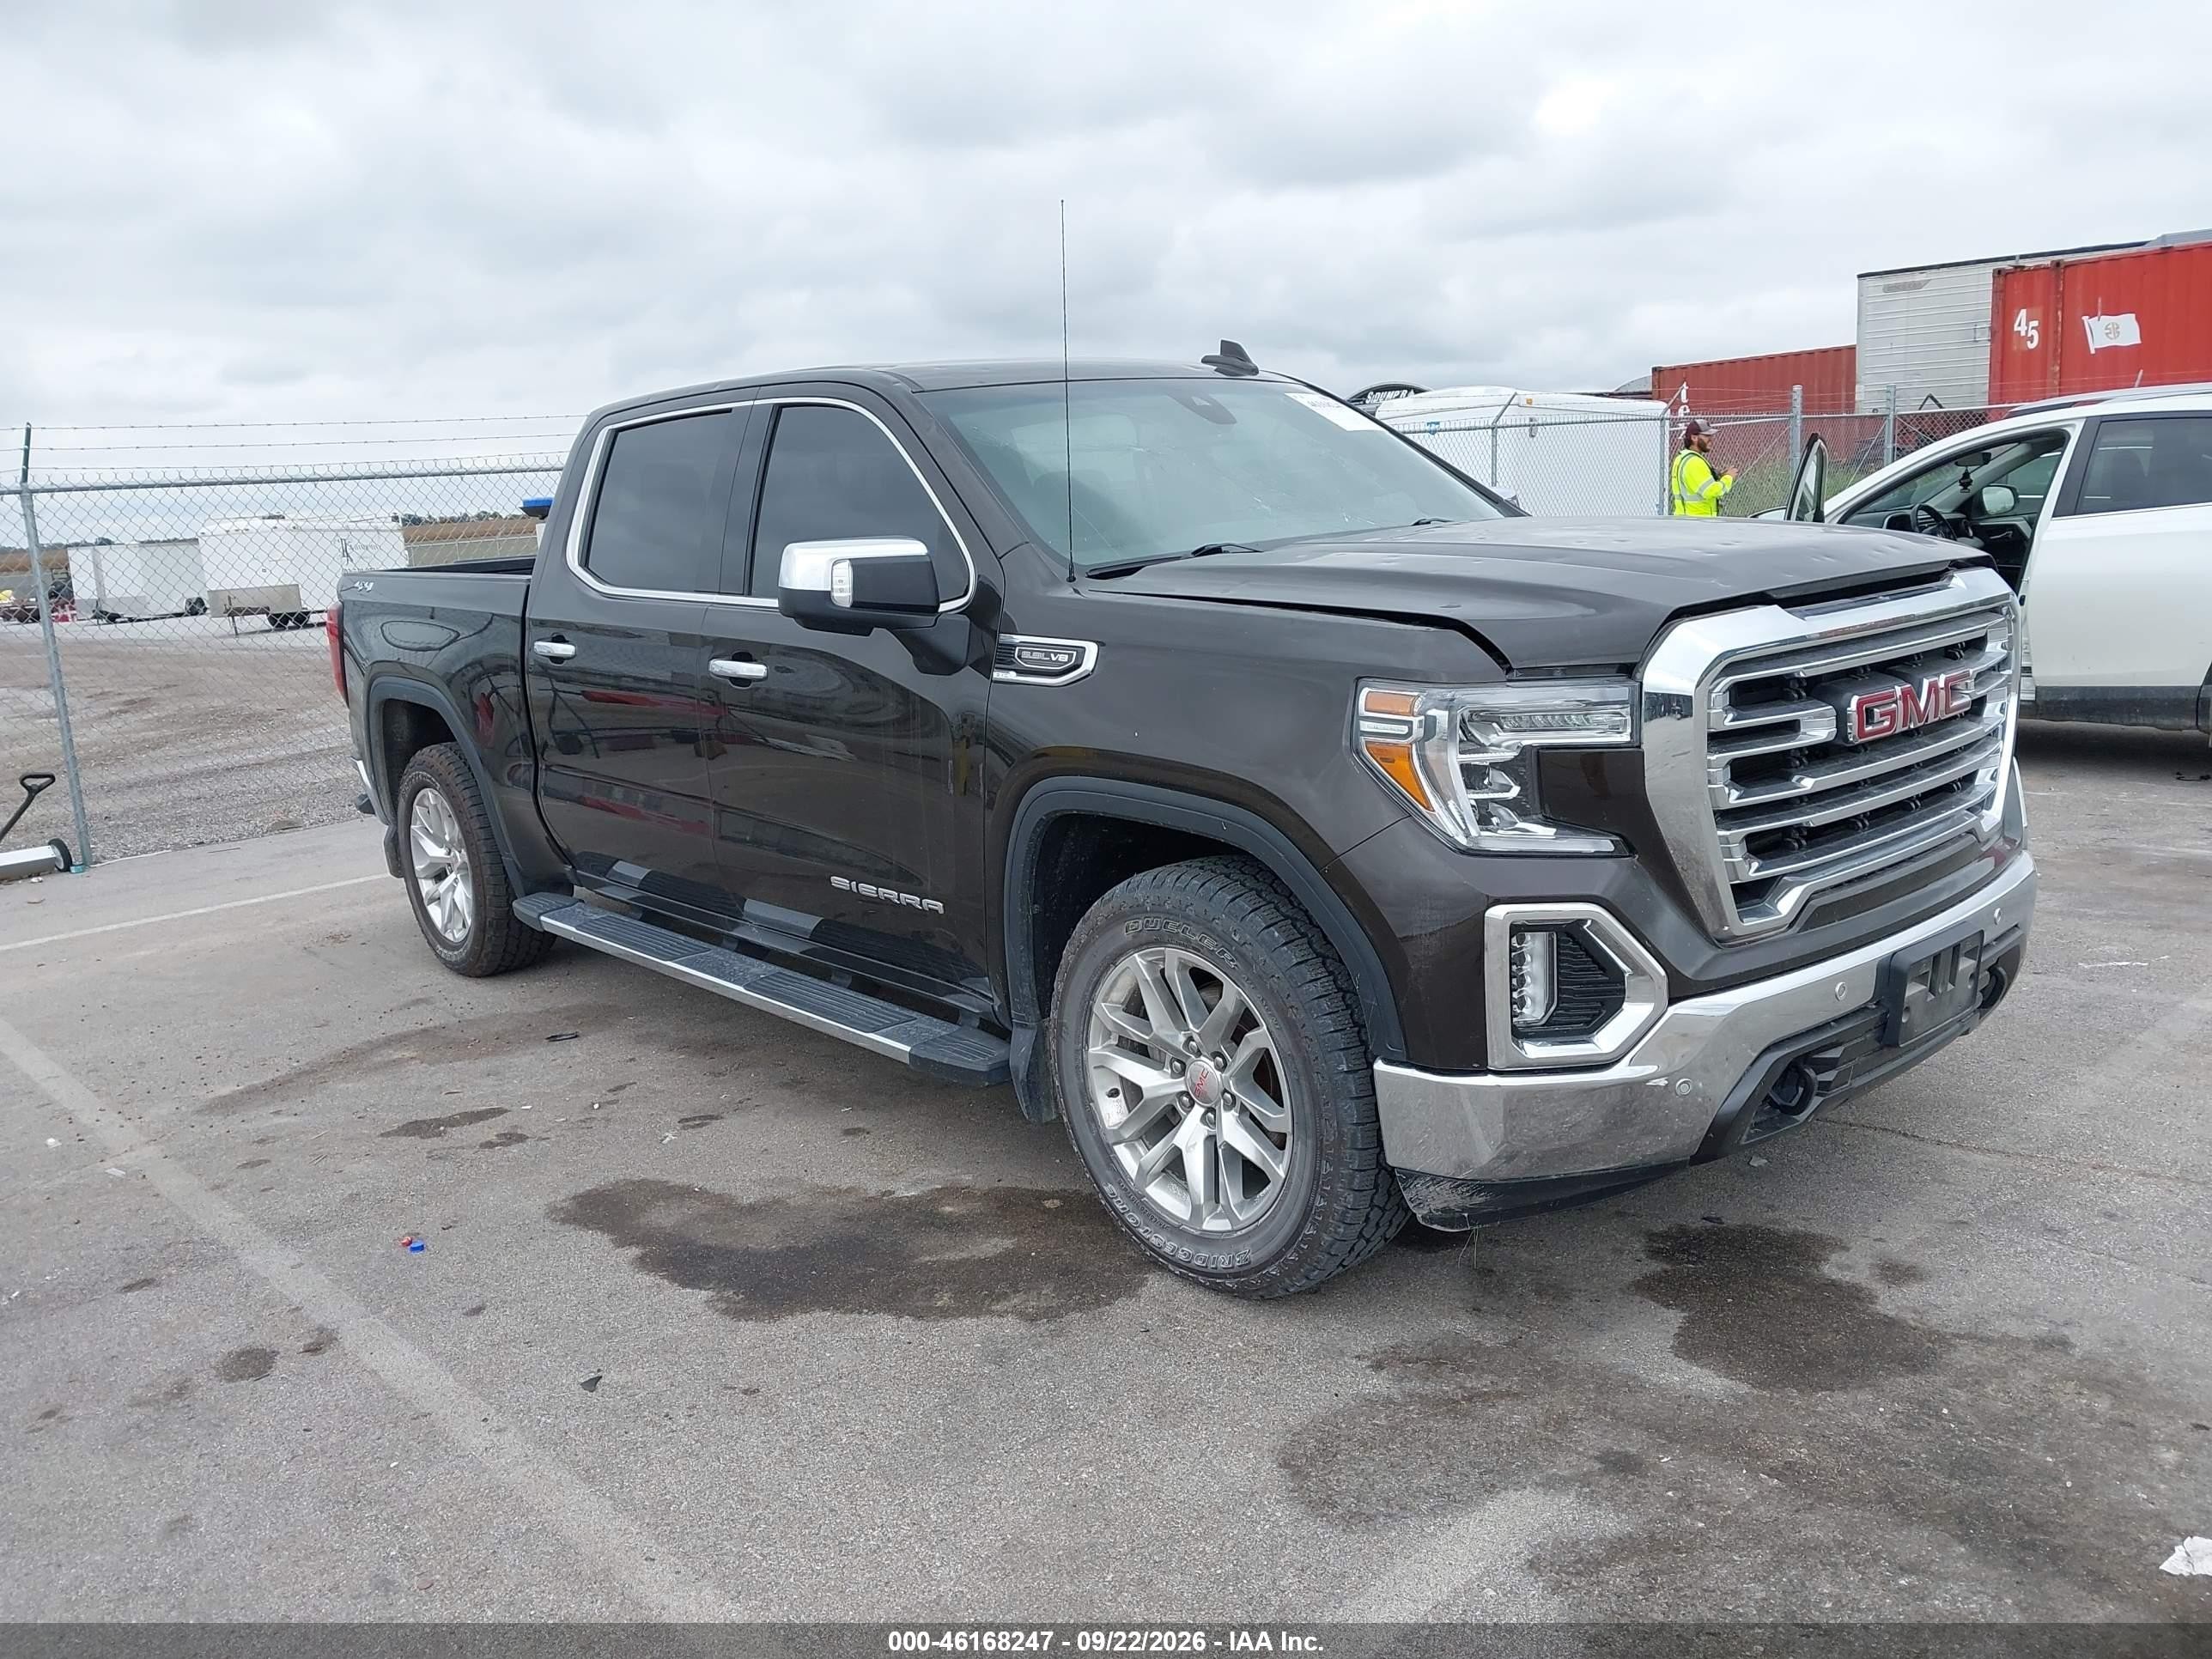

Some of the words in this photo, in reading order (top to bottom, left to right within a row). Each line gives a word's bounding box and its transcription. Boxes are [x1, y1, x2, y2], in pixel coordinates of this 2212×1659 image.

[2014, 309, 2039, 349] 45
[1850, 669, 1975, 744] GMC
[830, 876, 945, 915] SIERRA
[1125, 917, 1237, 969] DUELER
[1194, 1067, 1209, 1098] GMC
[1103, 1182, 1251, 1270] BRIDGESTONE
